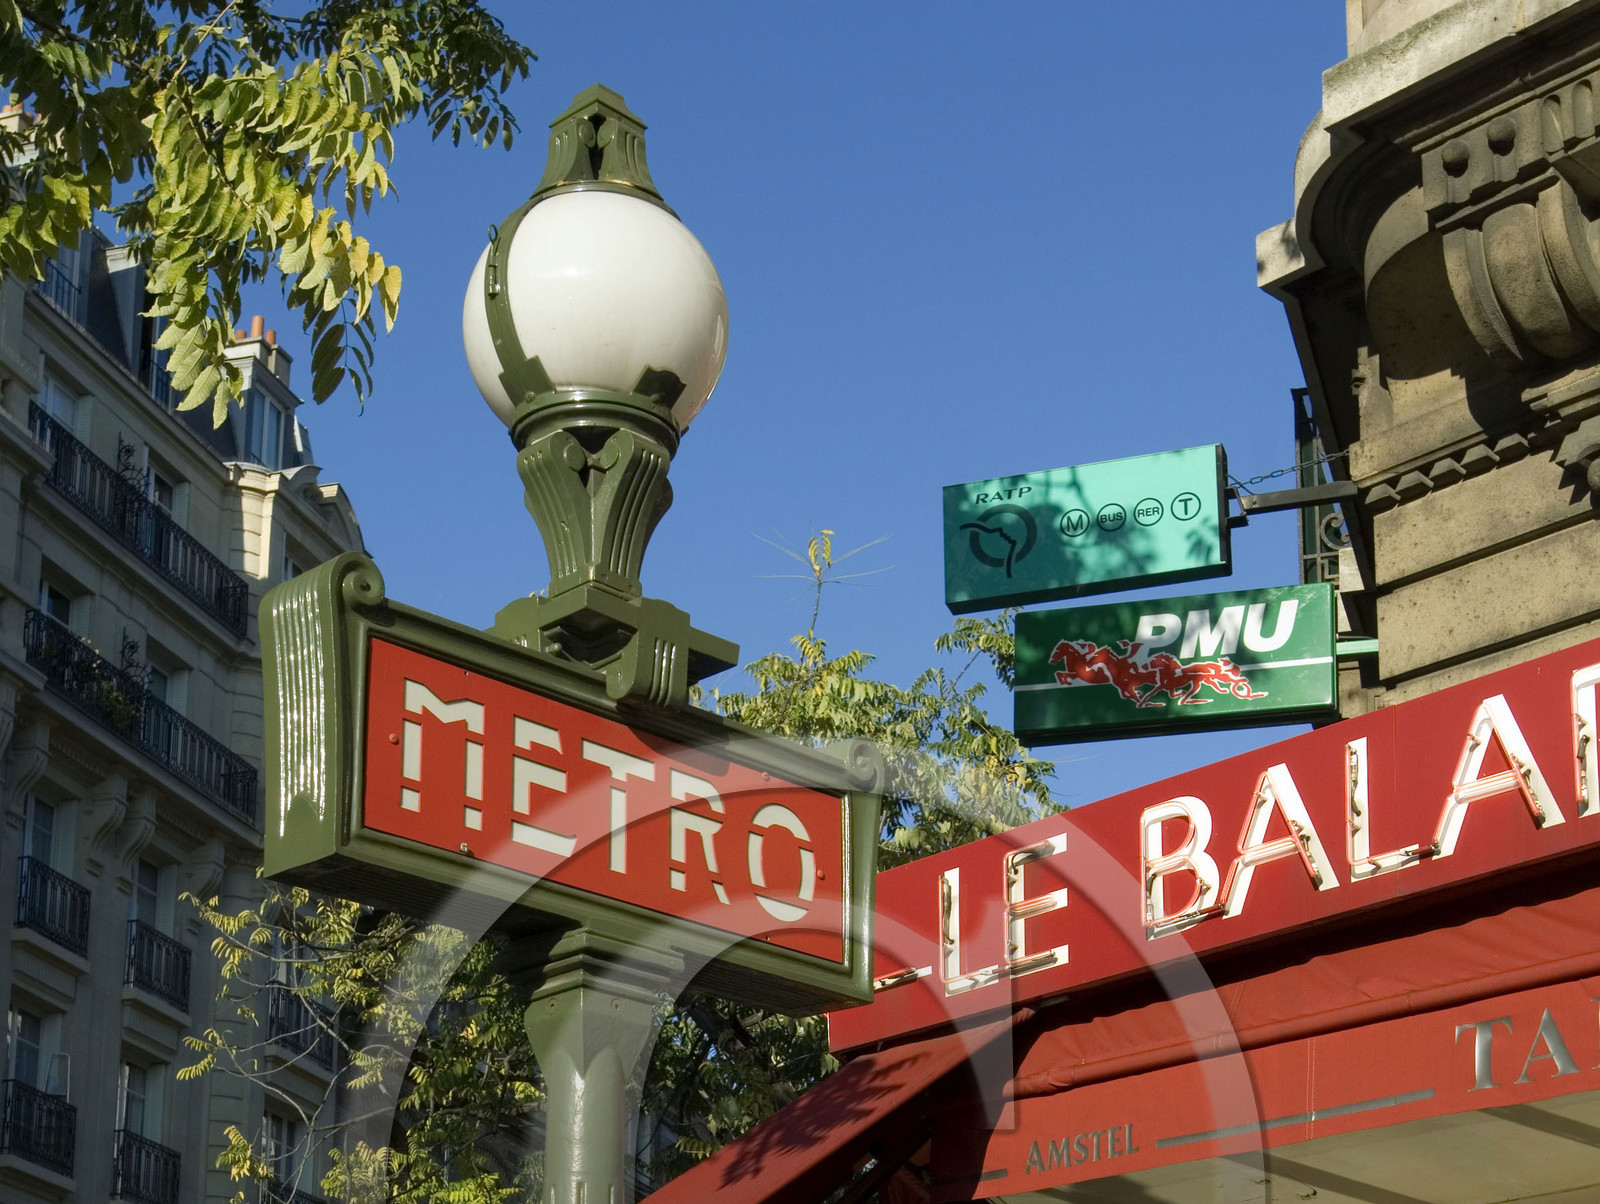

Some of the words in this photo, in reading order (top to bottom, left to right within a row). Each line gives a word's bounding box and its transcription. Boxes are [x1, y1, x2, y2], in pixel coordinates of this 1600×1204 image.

[974, 485, 1033, 505] RATP
[1099, 510, 1125, 524] BUS
[1137, 505, 1161, 518] RER
[1134, 599, 1299, 660] PMU
[401, 676, 816, 922] METRO
[938, 832, 1069, 997] LE
[1453, 998, 1600, 1093] TA
[1023, 1123, 1141, 1176] AMSTEL
